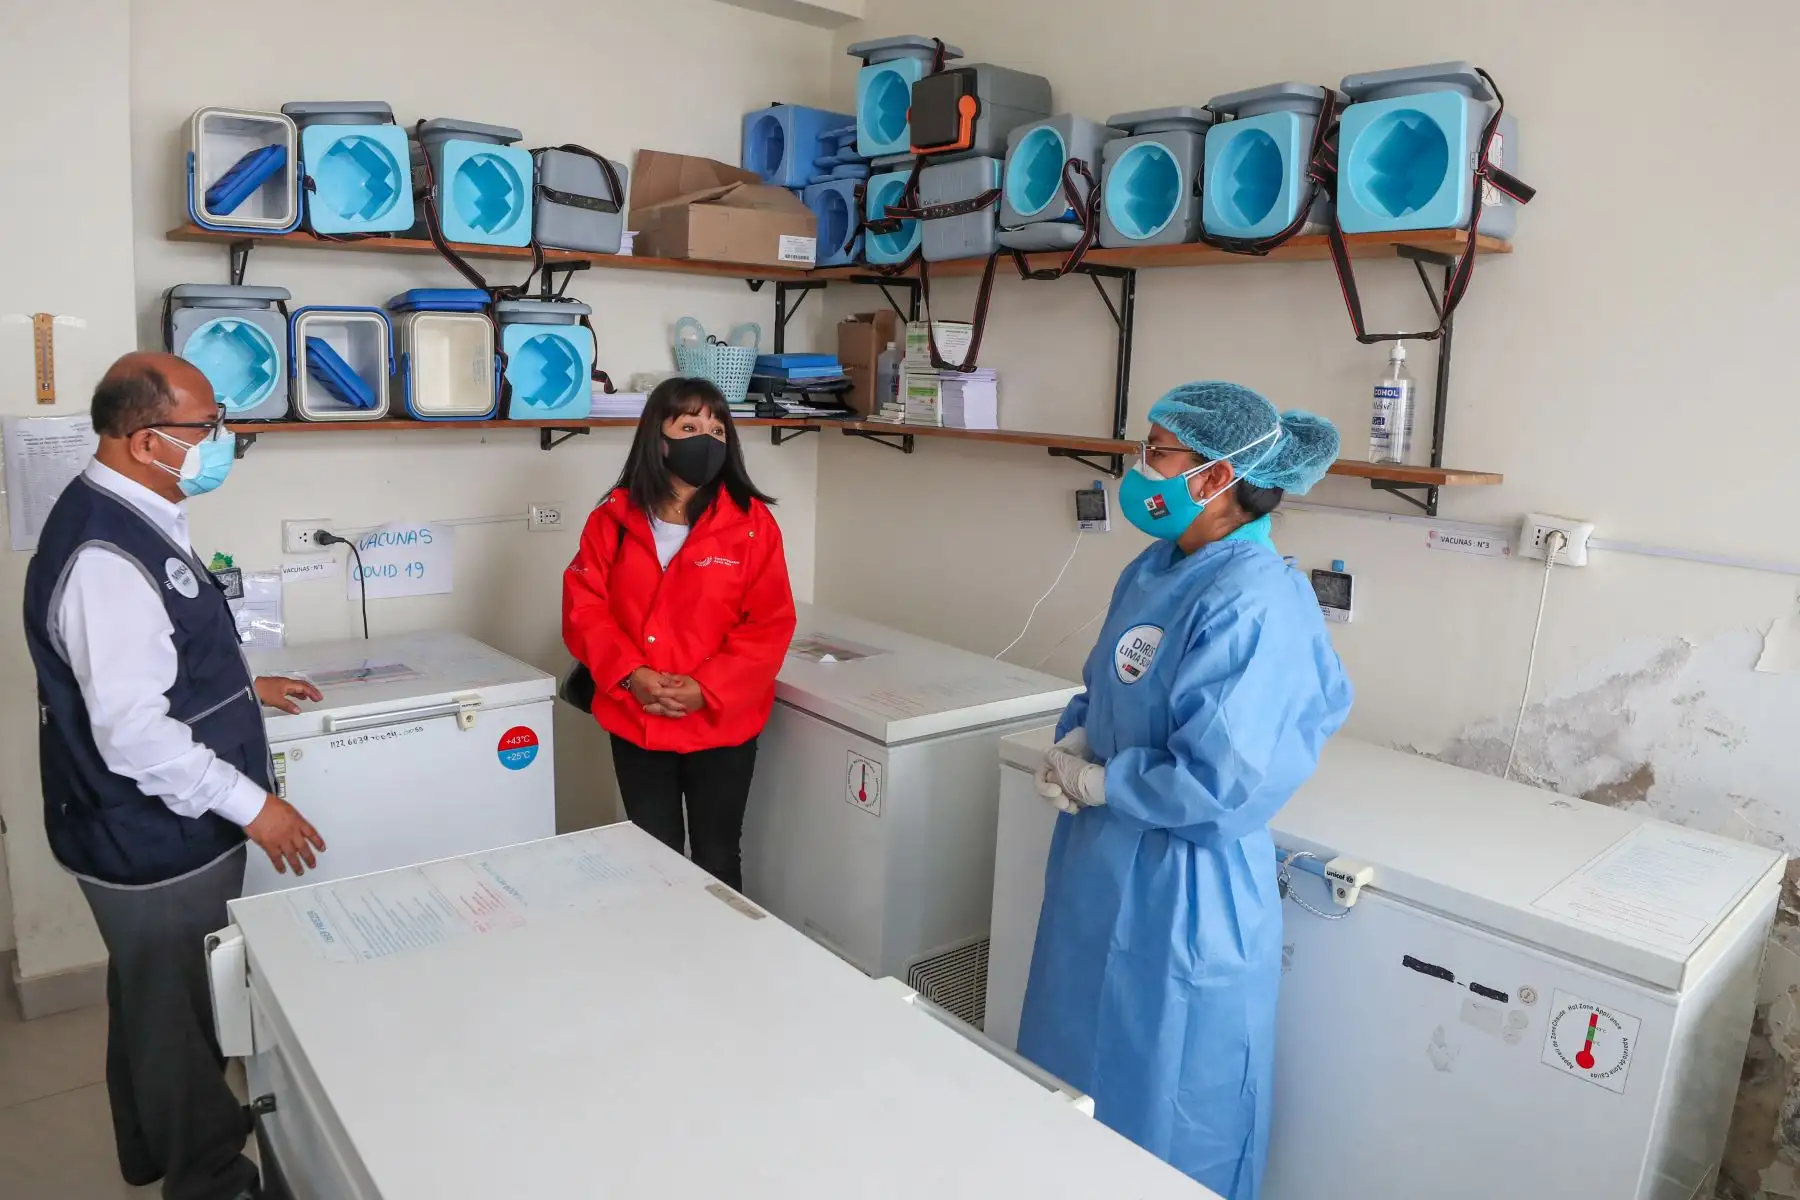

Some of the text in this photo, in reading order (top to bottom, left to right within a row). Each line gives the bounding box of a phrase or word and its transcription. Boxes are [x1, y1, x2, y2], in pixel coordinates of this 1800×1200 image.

[359, 528, 433, 551] VACUNAS
[1440, 536, 1472, 547] VACUNAS
[282, 565, 310, 574] VACUNAS
[353, 561, 424, 581] COVID 19
[1120, 645, 1142, 663] LIMA
[1132, 638, 1156, 657] DIRIS
